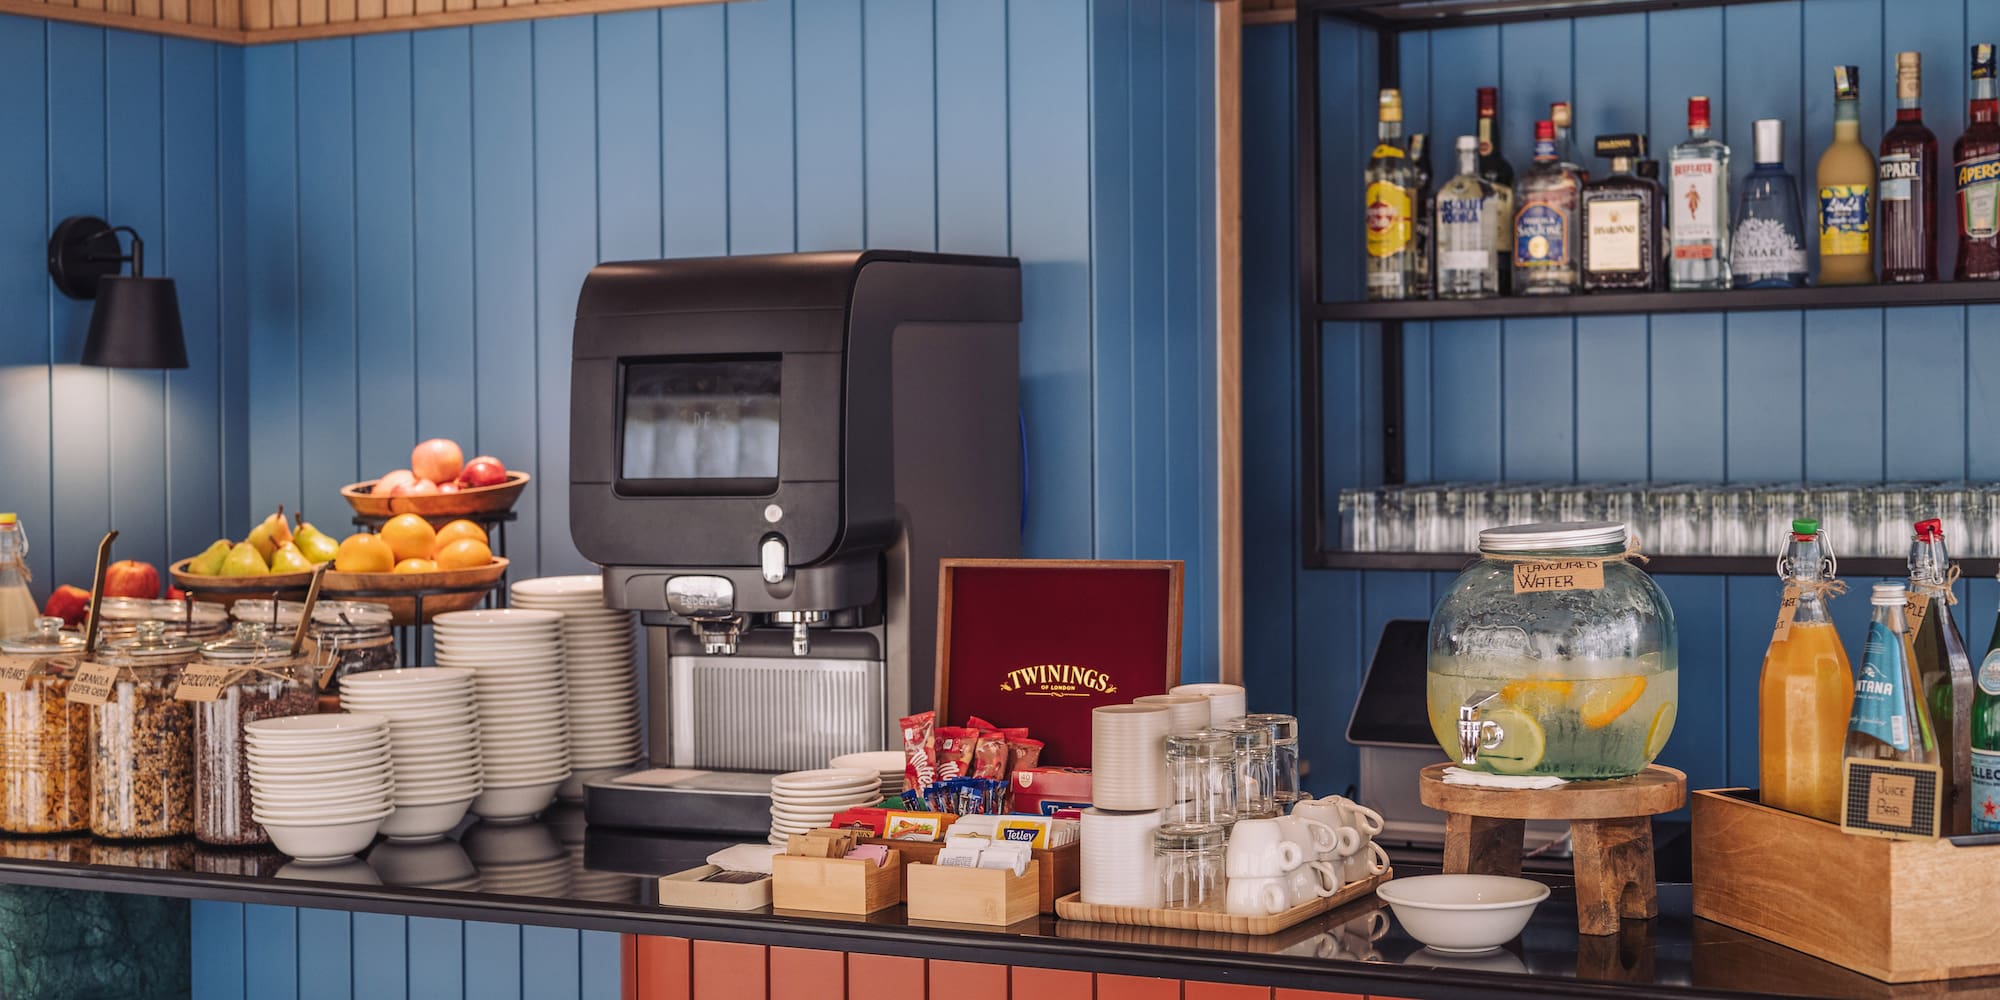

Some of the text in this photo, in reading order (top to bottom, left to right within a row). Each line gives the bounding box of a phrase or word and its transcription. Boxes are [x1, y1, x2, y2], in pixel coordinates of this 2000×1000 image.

[1517, 561, 1598, 573] FLAVOURED
[1517, 572, 1574, 589] WATER
[1008, 664, 1110, 692] TWININGS
[1007, 830, 1035, 842] Tetley
